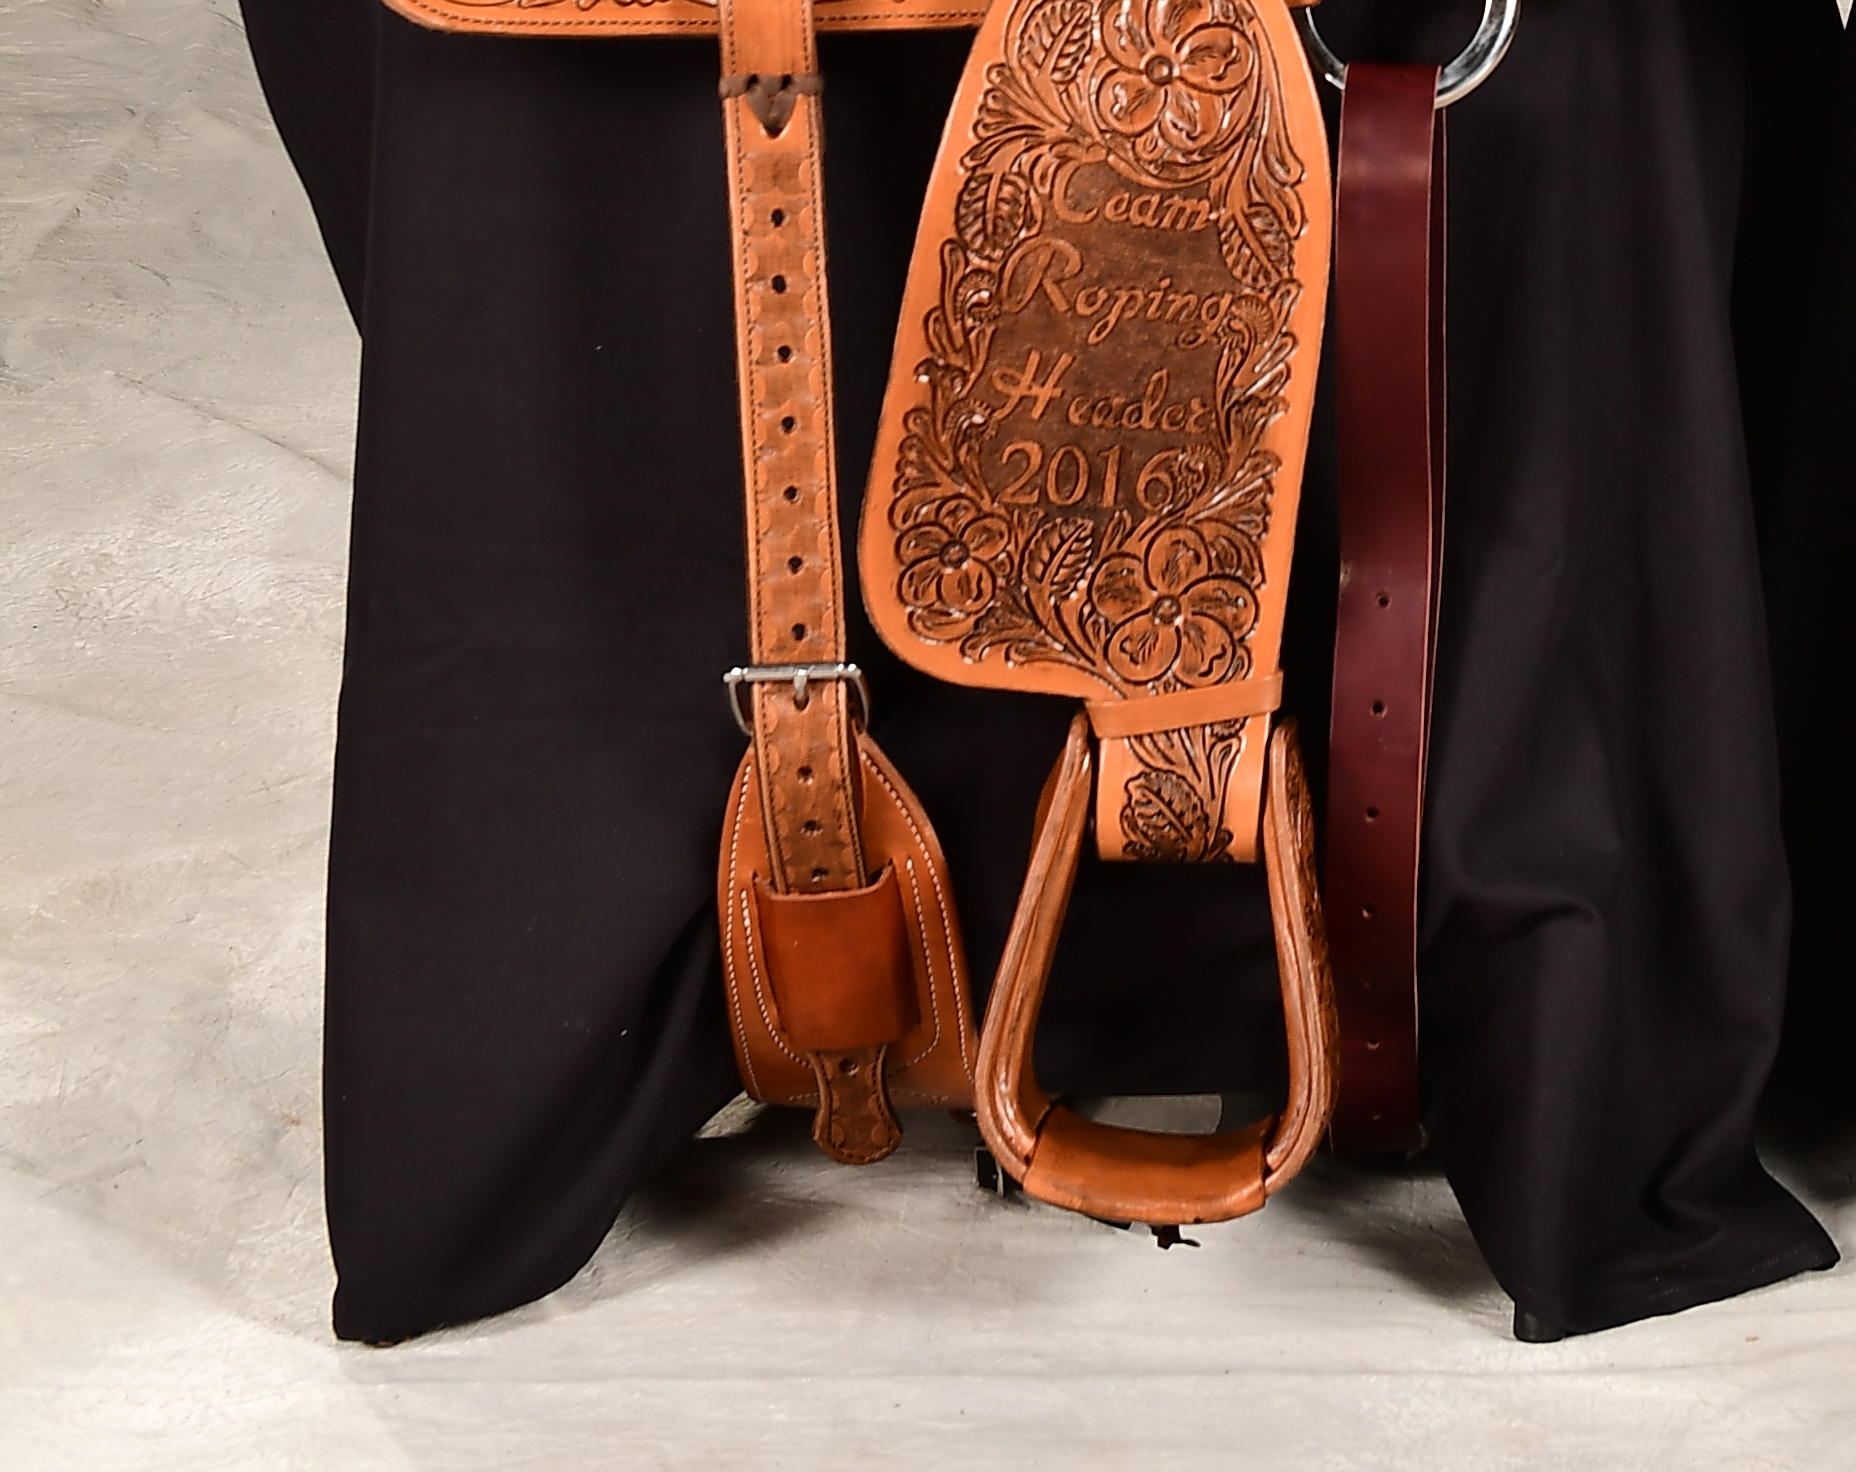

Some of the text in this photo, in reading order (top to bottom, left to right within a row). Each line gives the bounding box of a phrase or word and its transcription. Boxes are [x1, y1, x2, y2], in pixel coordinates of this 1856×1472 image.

[1000, 236, 1233, 349] Roping
[990, 349, 1214, 434] Header
[999, 439, 1181, 511] 2016
